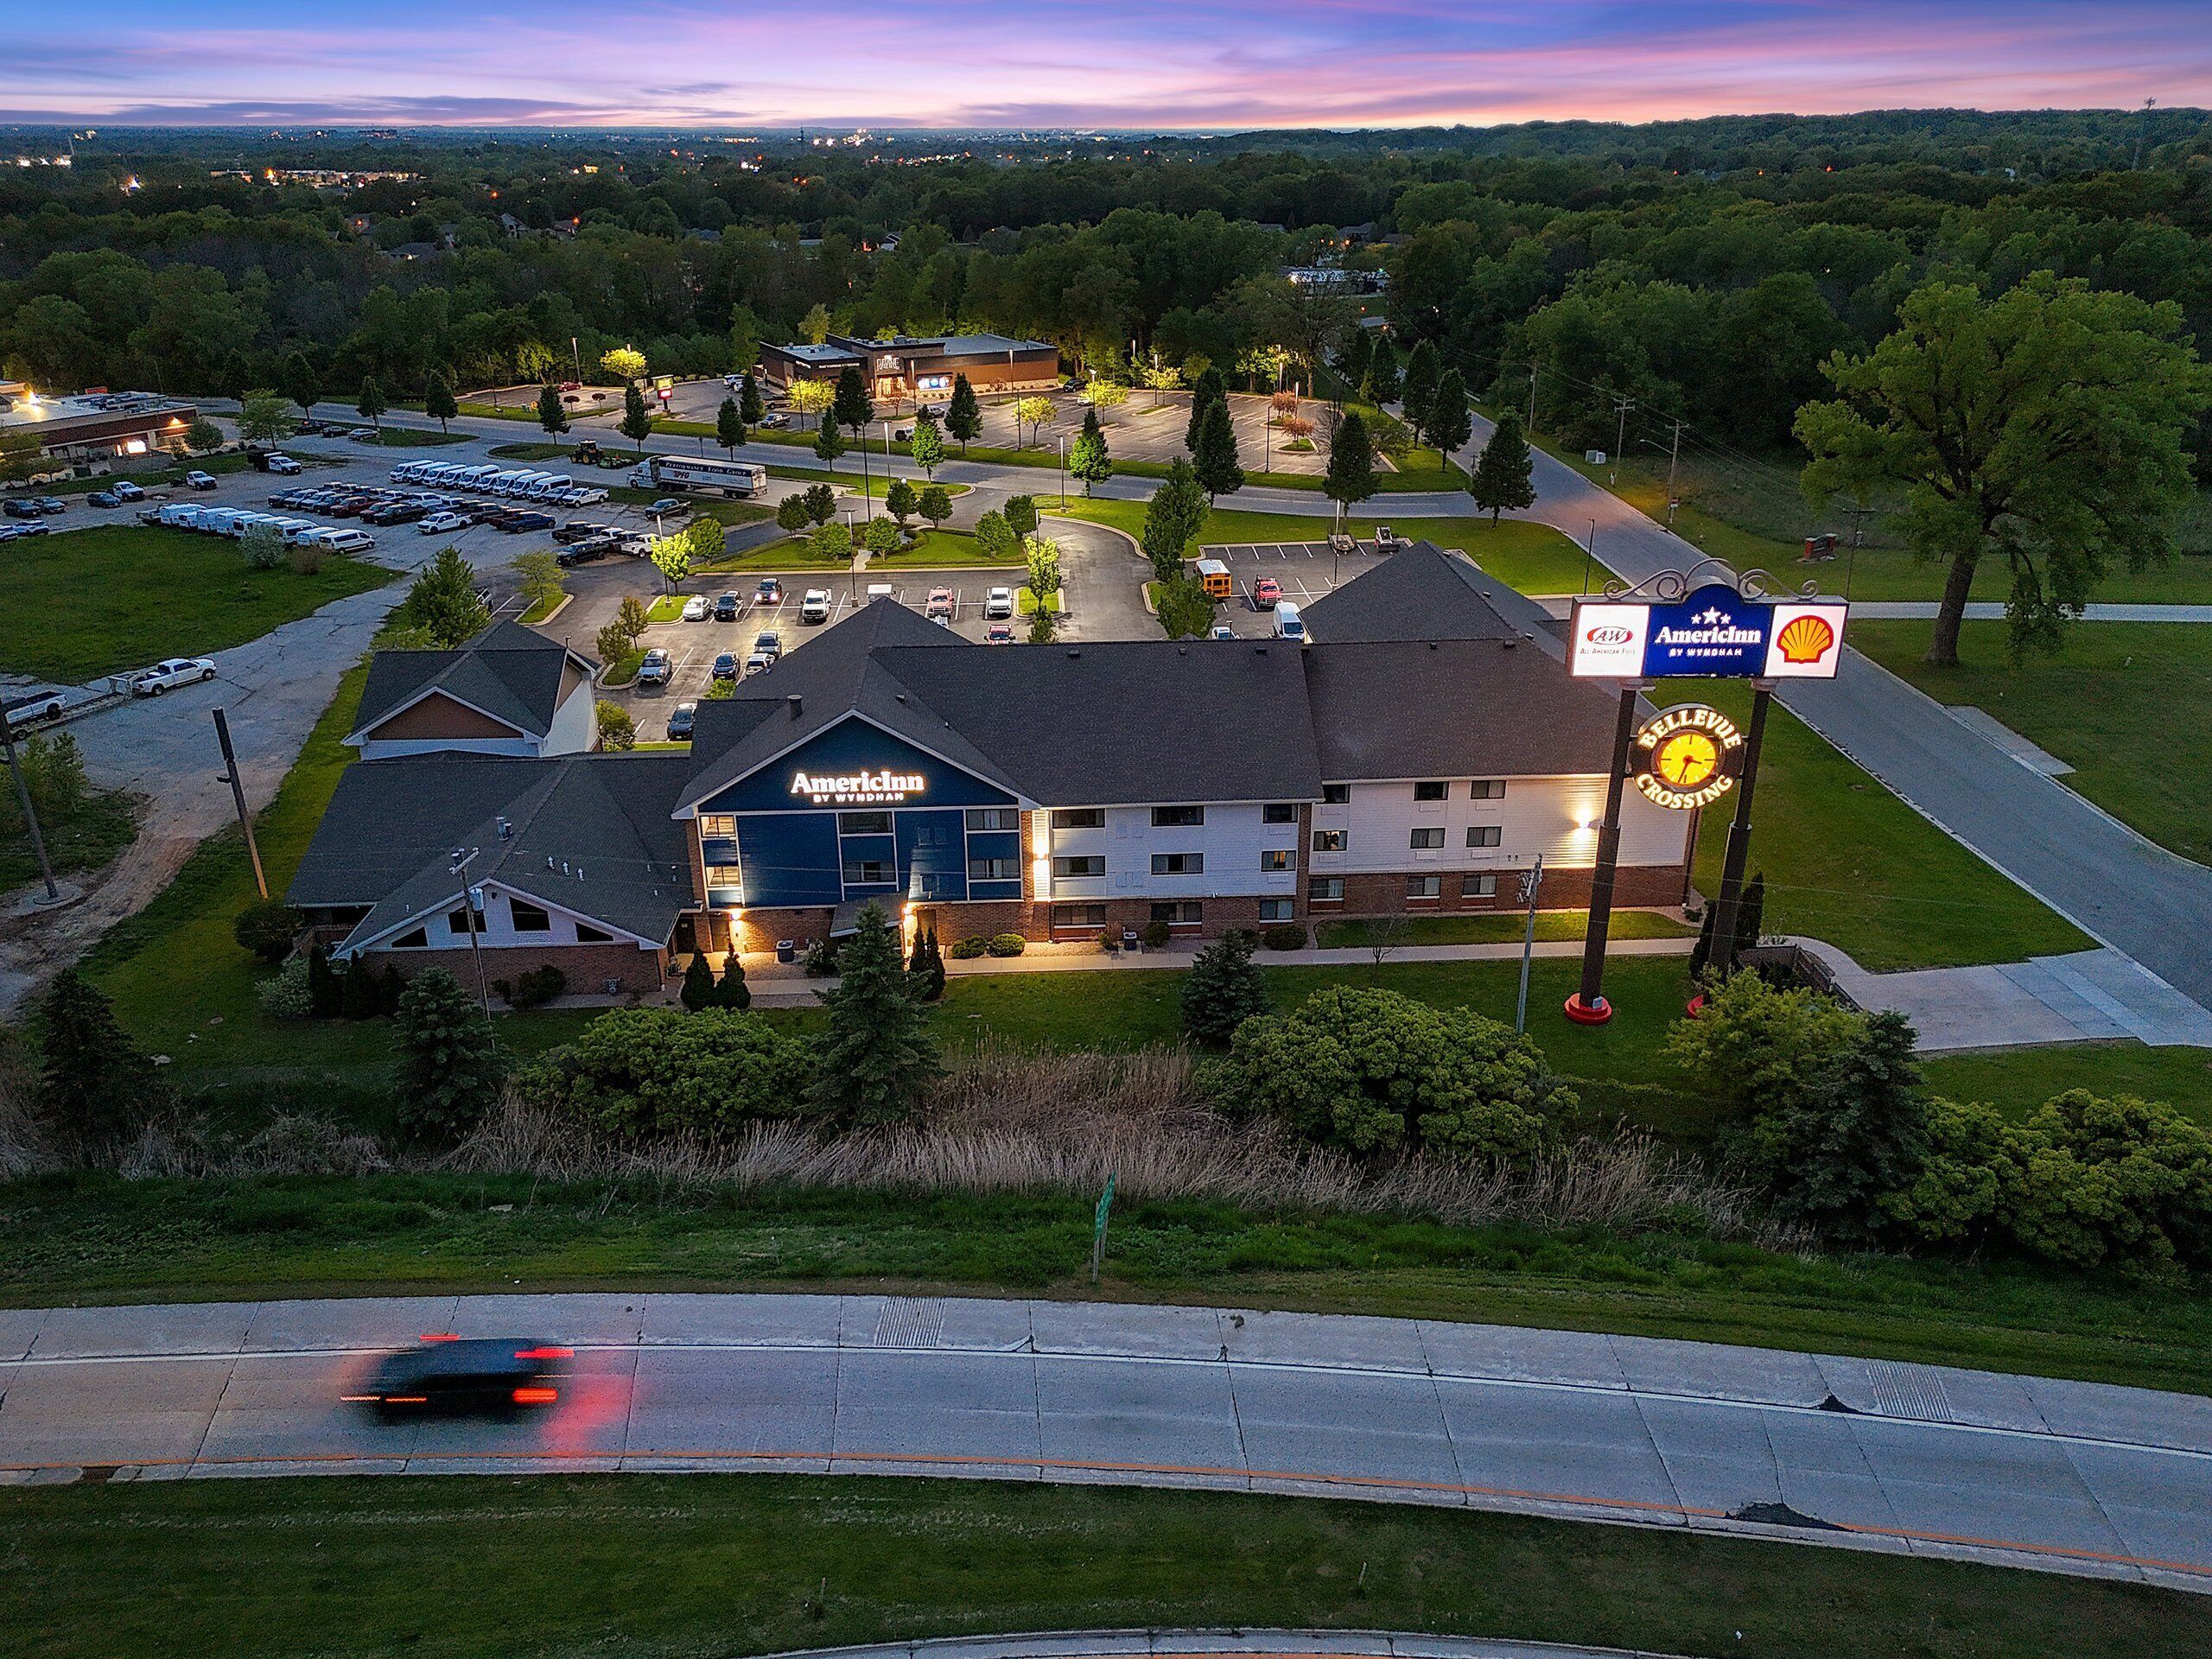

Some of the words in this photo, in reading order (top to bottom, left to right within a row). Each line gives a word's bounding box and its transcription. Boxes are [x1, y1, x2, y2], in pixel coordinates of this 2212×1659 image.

[1655, 626, 1761, 644] AmericInn
[1669, 648, 1683, 658] BY
[1687, 648, 1743, 657] WYNDHAM
[1637, 709, 1742, 749] BELLEVUE
[791, 771, 925, 794] AmericInn
[1637, 773, 1733, 810] CROSSING
[813, 794, 830, 803] BY
[835, 792, 905, 803] WYNDHAM
